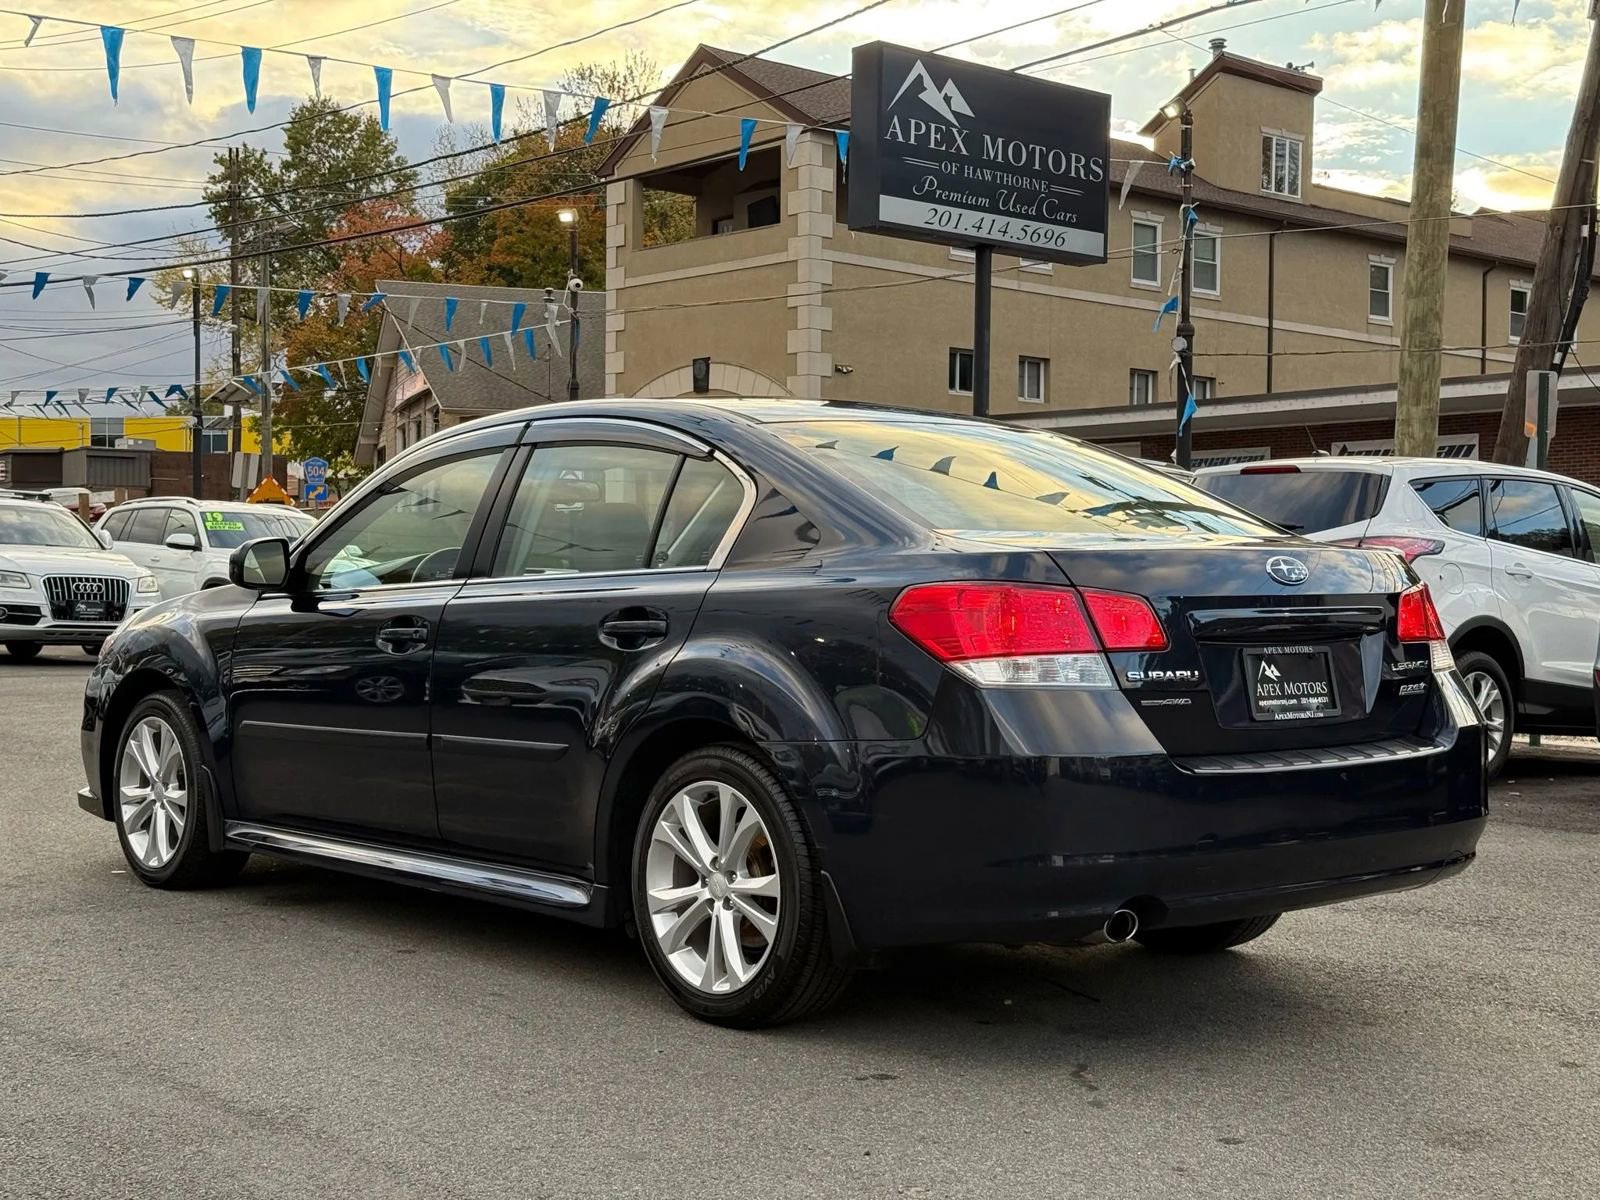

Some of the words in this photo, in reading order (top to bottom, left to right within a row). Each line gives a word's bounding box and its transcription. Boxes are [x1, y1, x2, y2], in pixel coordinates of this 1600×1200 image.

[884, 115, 970, 156] APEX
[981, 134, 1104, 182] MOTORS
[941, 160, 960, 175] OF
[964, 165, 1049, 193] HAWTHORNE
[912, 175, 990, 208] Premium
[996, 189, 1046, 216] Used
[1043, 198, 1078, 223] Cars
[923, 207, 1068, 247] 201.414.5696
[307, 465, 325, 477] 504
[206, 512, 223, 521] 19
[1126, 670, 1200, 682] SUBARU
[1257, 682, 1282, 696] APEX
[1283, 681, 1328, 696] MOTORS
